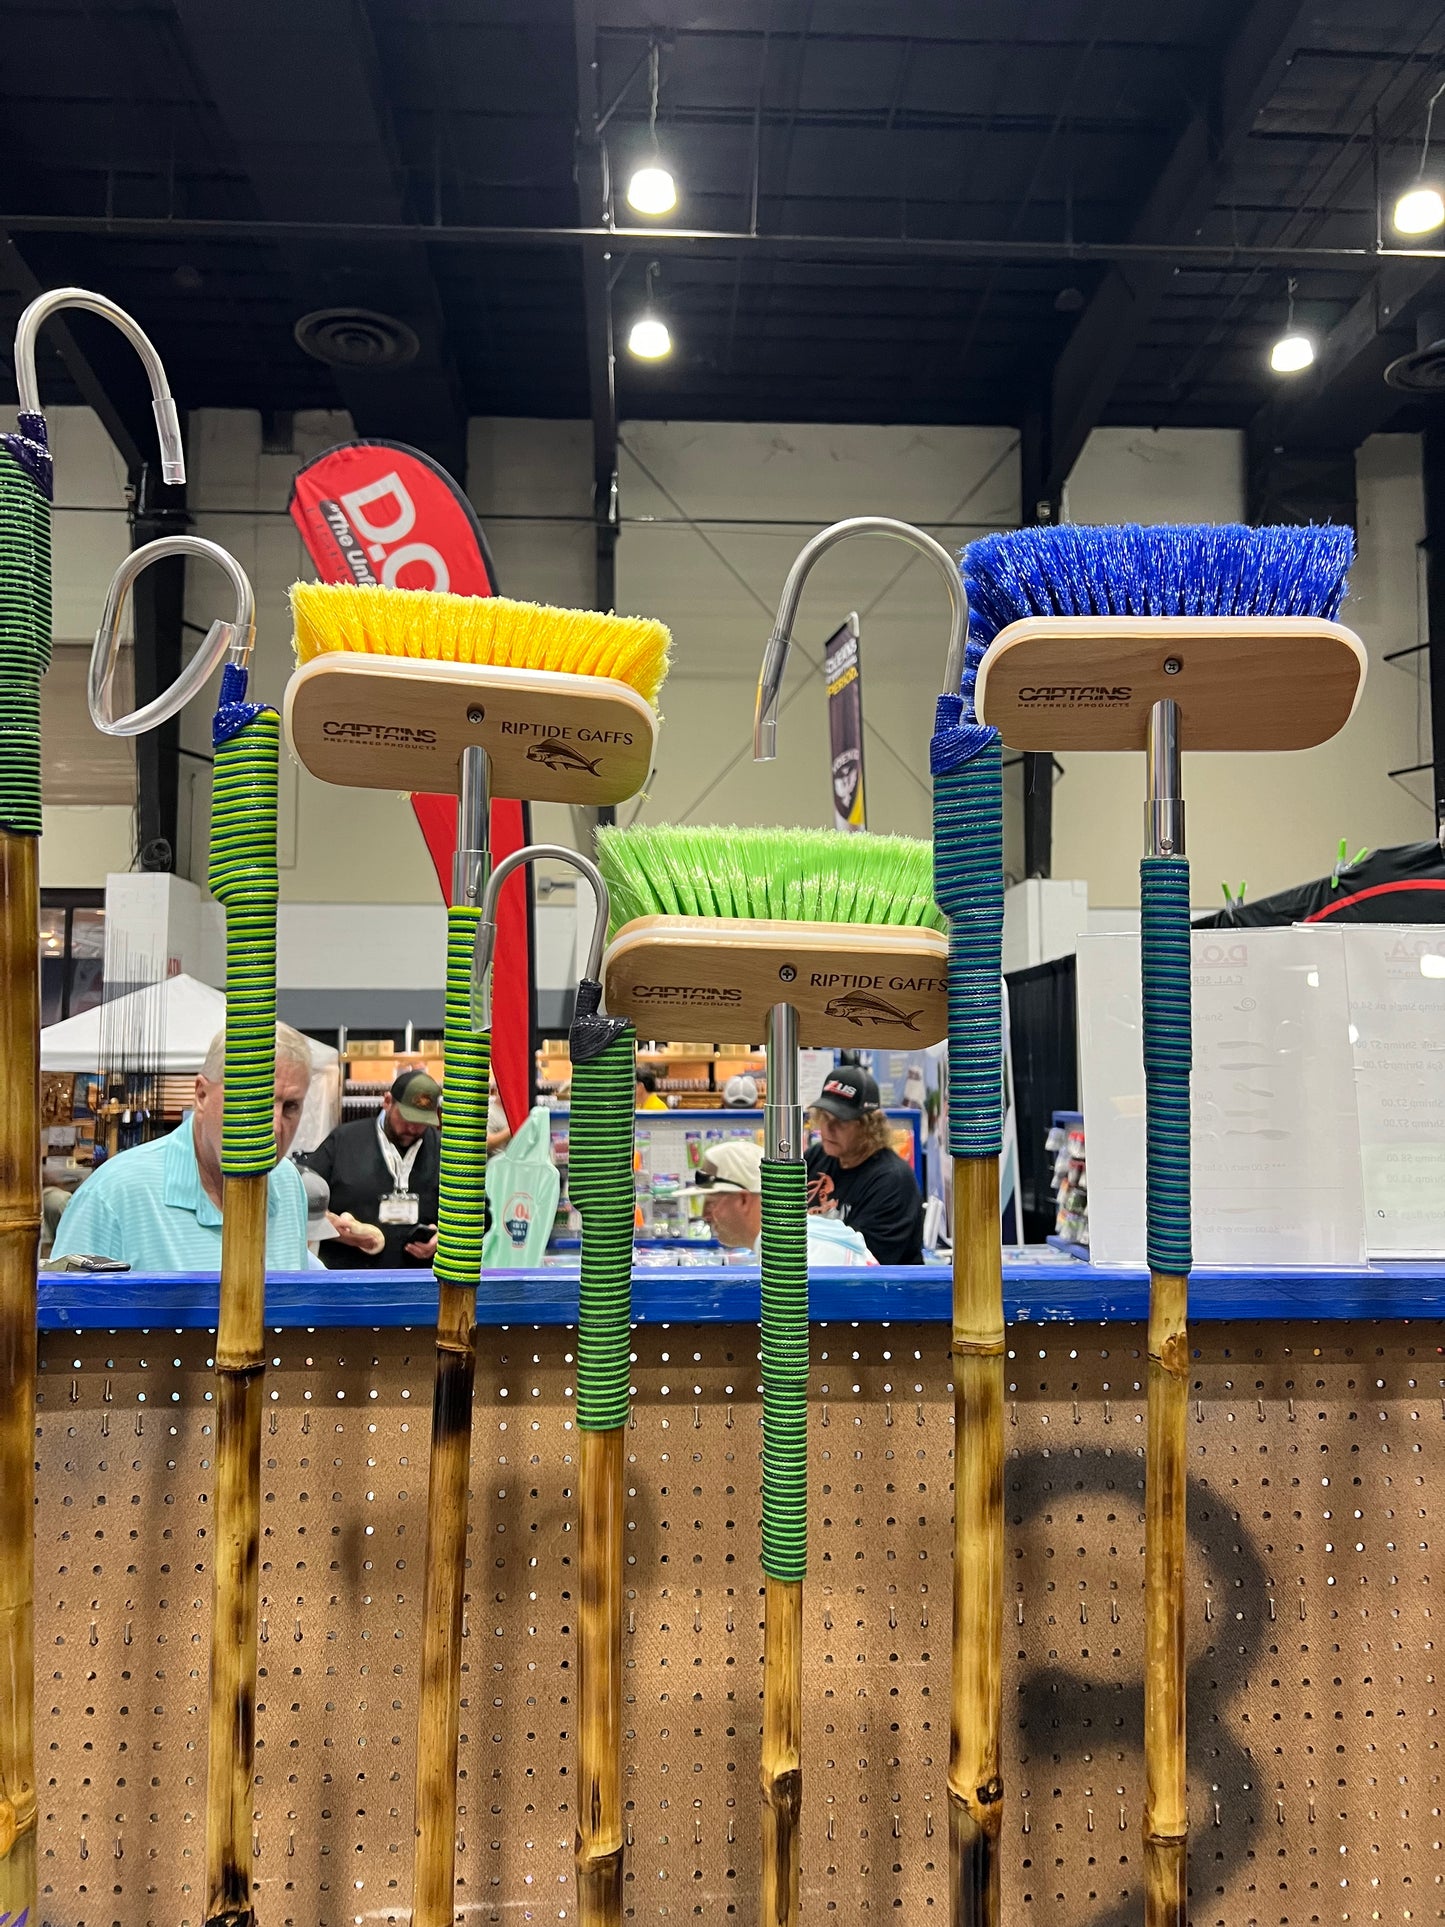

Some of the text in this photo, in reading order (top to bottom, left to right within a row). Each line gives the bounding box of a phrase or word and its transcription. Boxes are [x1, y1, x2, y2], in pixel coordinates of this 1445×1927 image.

[1018, 687, 1132, 701] CAPTAINS
[322, 720, 438, 744] CAPTAINS
[500, 720, 634, 746] RIPTIDE GAFFS
[384, 742, 437, 751] PRODUCTS
[810, 973, 948, 993] RIPTIDE GAFFS
[631, 985, 743, 1001] CAPTAINS
